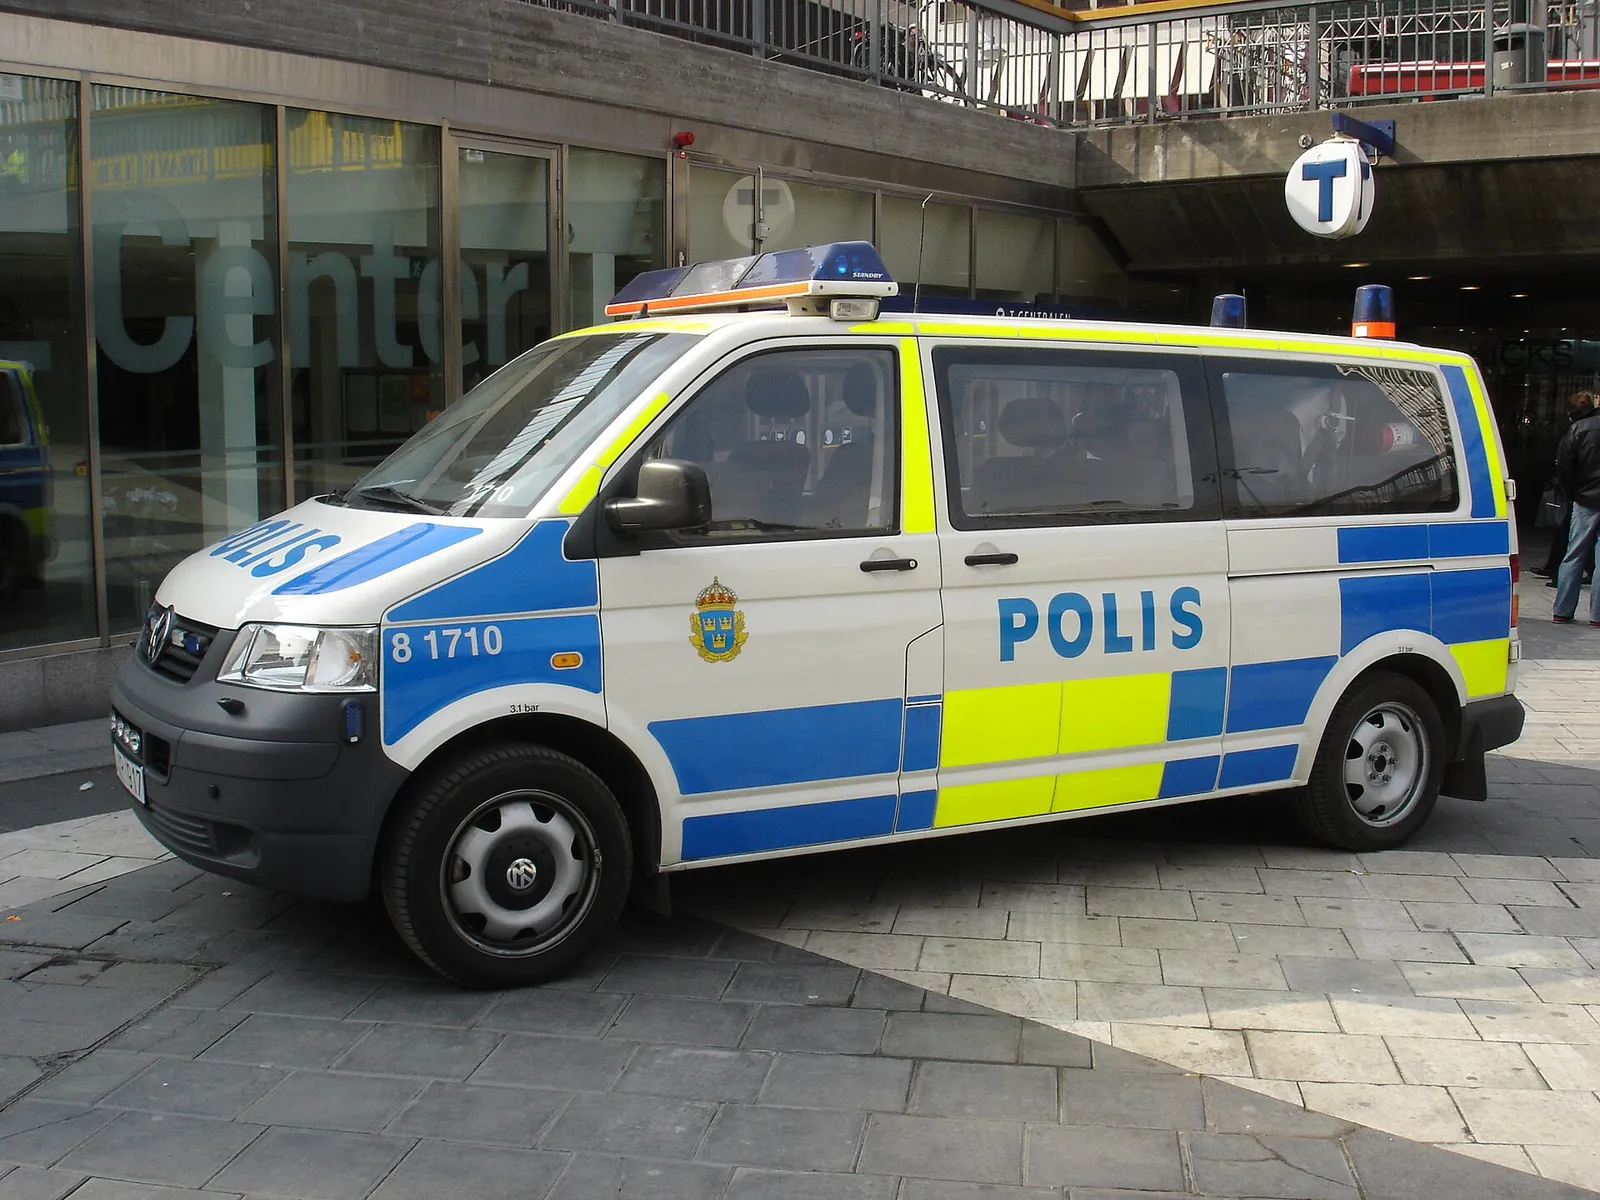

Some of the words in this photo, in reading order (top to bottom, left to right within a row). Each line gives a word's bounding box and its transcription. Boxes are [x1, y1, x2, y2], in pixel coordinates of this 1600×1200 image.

[1302, 158, 1347, 222] T
[93, 190, 529, 374] Center
[392, 632, 412, 663] 8
[424, 625, 502, 660] 1710
[998, 586, 1204, 662] POLIS
[510, 704, 521, 713] 3.1
[525, 704, 539, 712] bar
